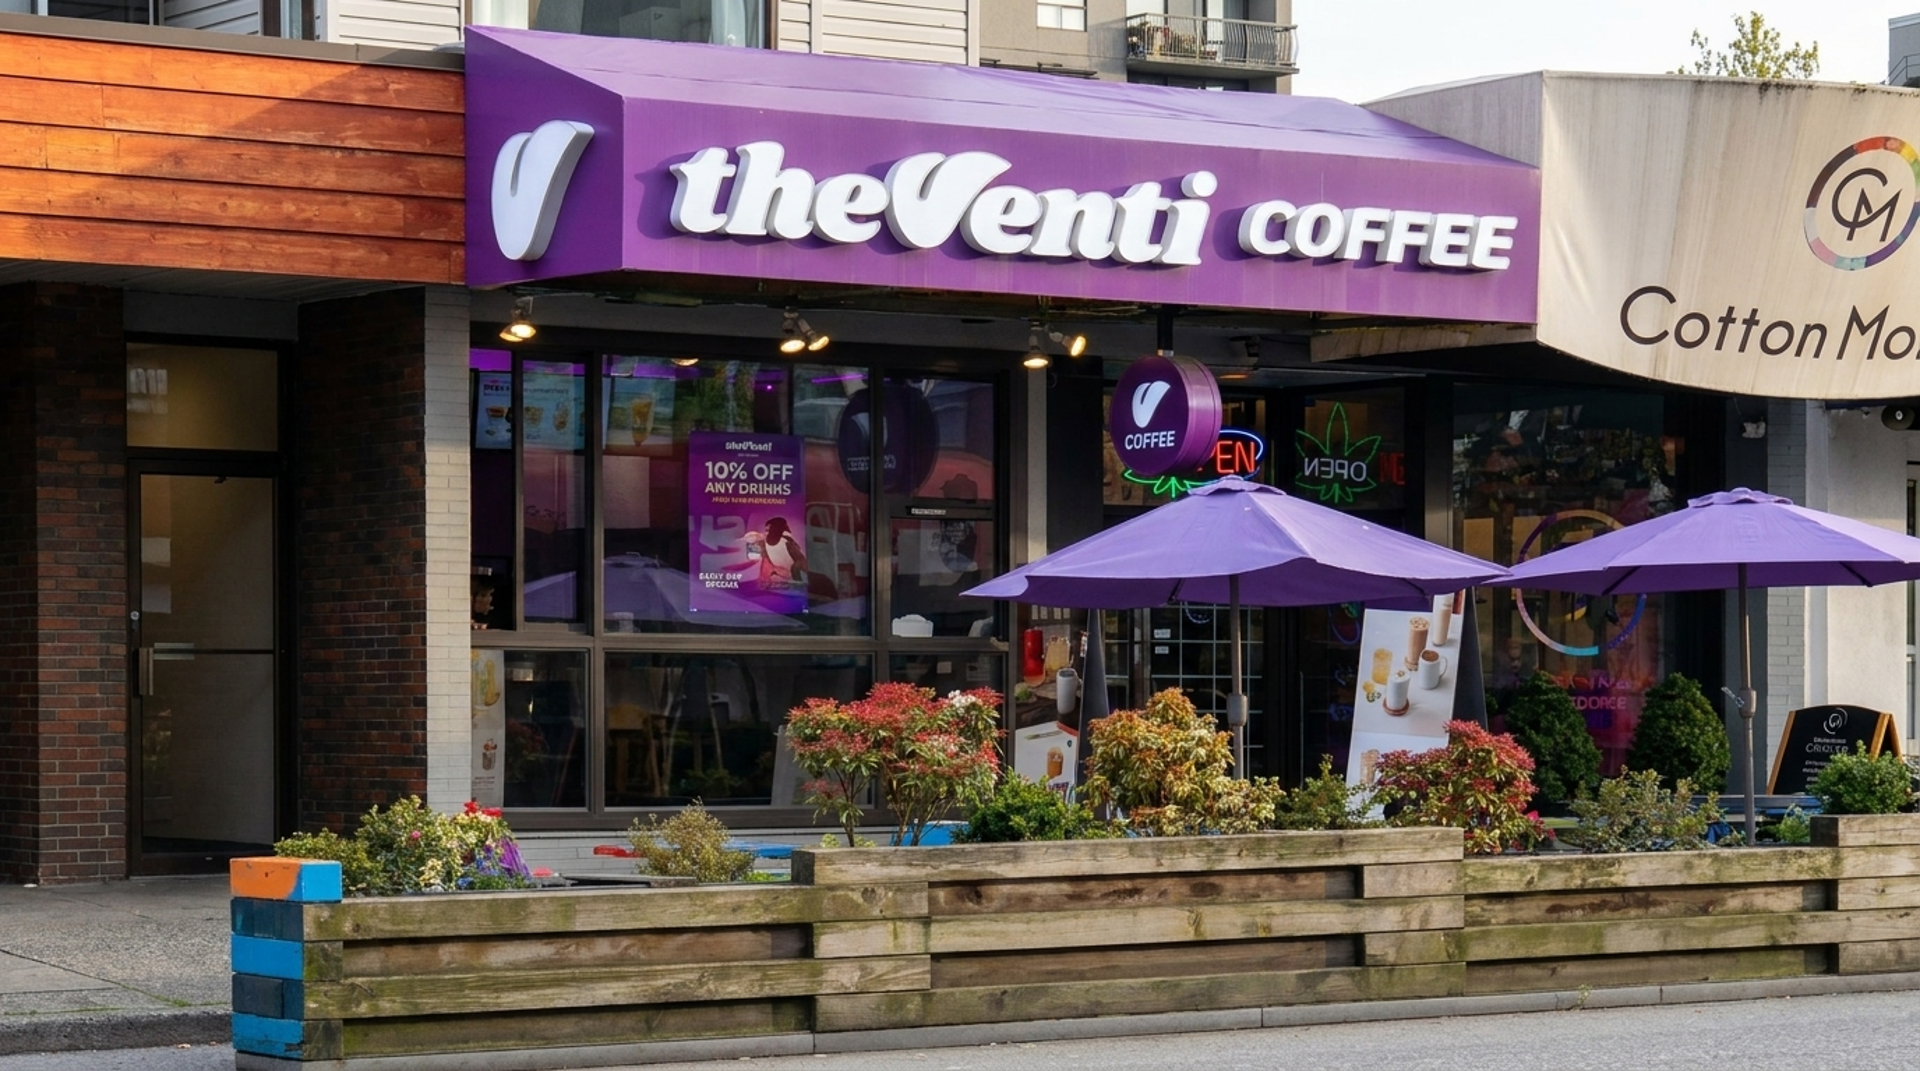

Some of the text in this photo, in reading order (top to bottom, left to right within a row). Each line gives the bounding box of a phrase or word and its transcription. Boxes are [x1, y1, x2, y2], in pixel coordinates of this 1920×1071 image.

[1238, 199, 1518, 271] COFFEE
[1619, 285, 1920, 361] Cotton Mo
[1125, 430, 1176, 450] COFFEE
[705, 461, 794, 481] 10% OFF
[705, 482, 735, 494] ANY
